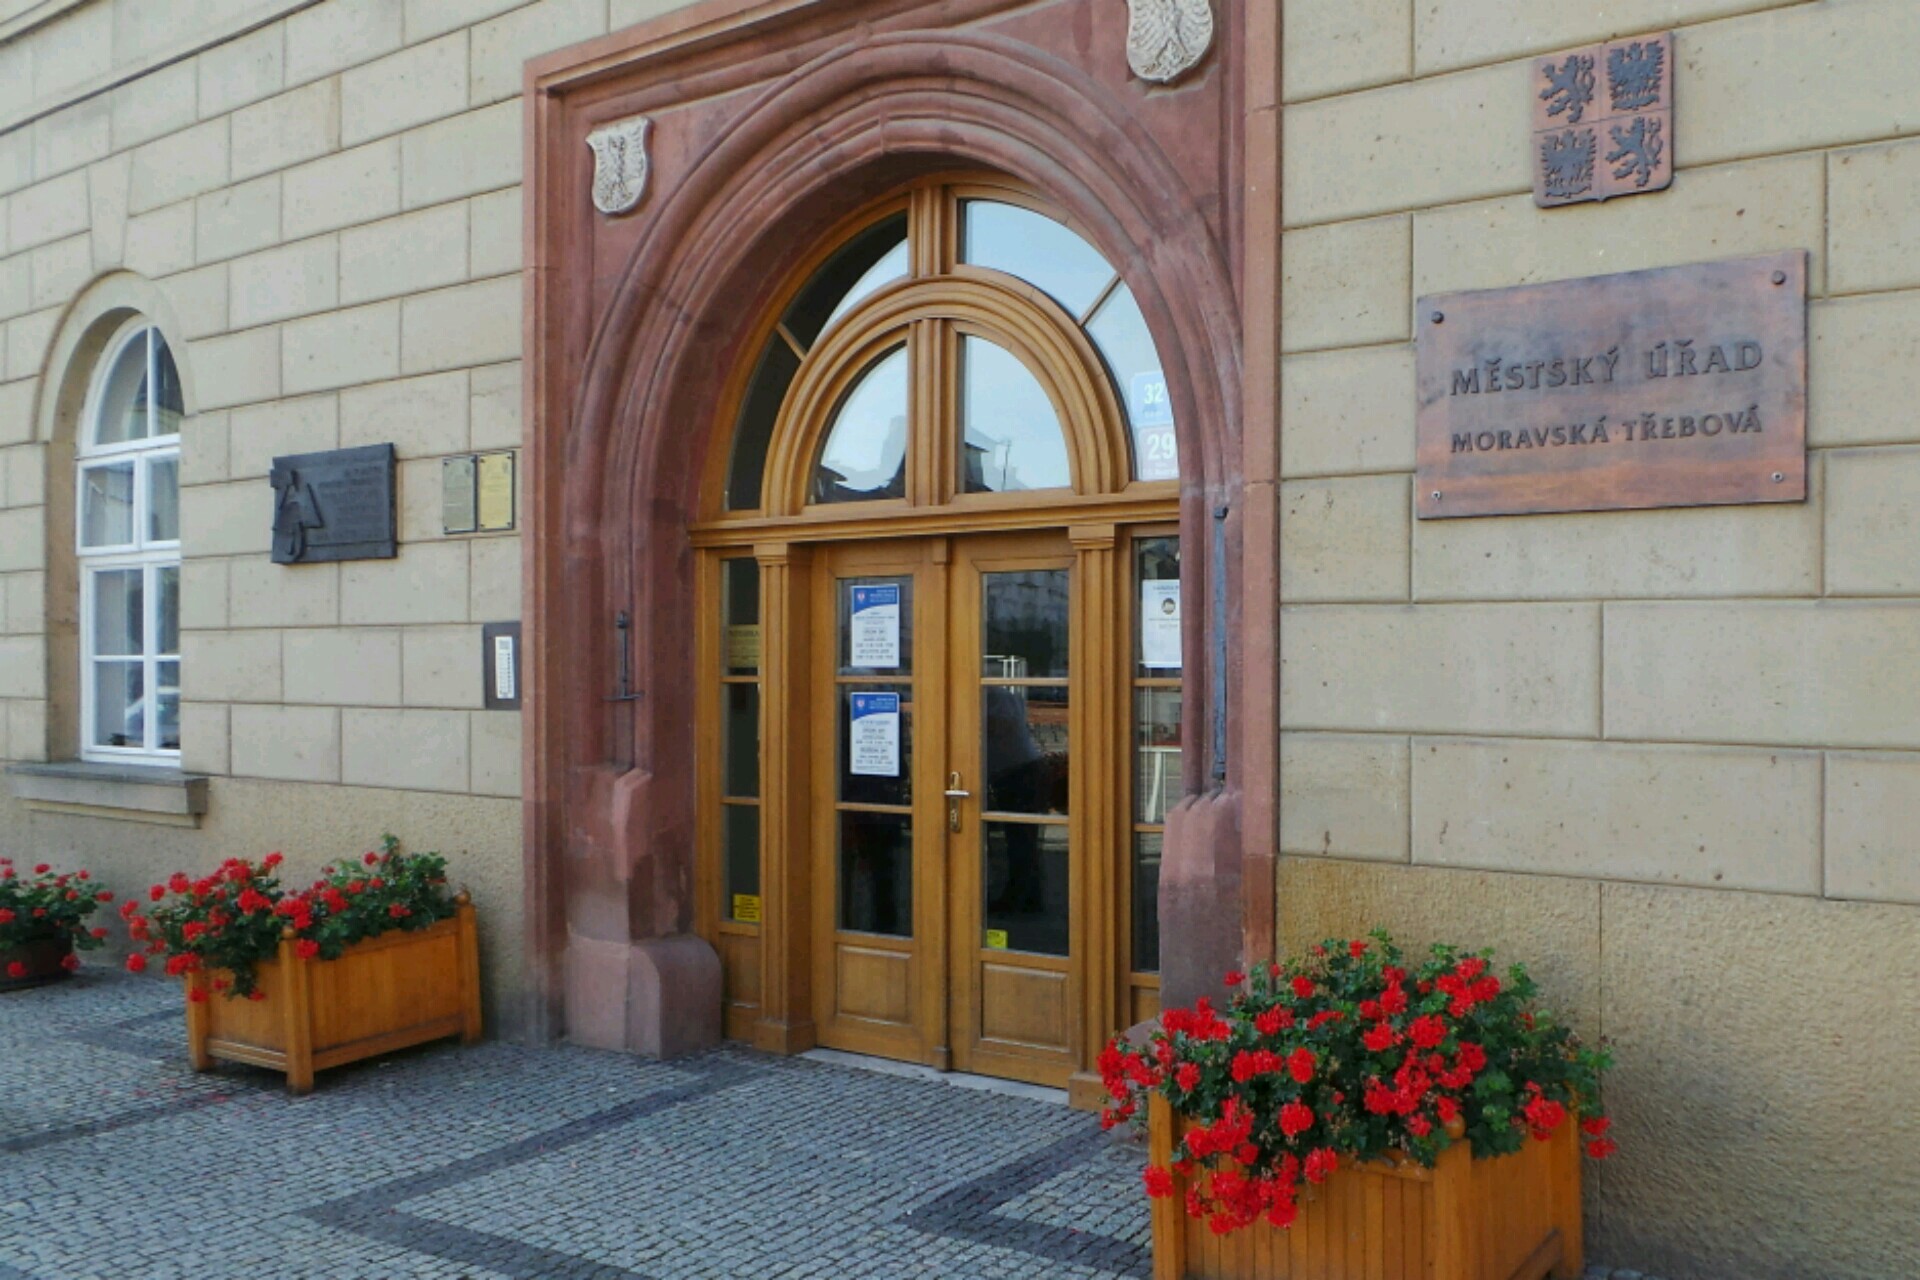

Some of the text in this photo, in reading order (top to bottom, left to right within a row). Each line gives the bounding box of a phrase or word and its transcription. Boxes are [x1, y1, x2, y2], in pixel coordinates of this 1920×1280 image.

[1450, 339, 1763, 396] MĚSTSKÝ ÚŘAD
[1143, 382, 1165, 405] 32
[1146, 432, 1175, 461] 29
[1451, 403, 1763, 454] MORAVSKÁ TŘEBOVÁ
